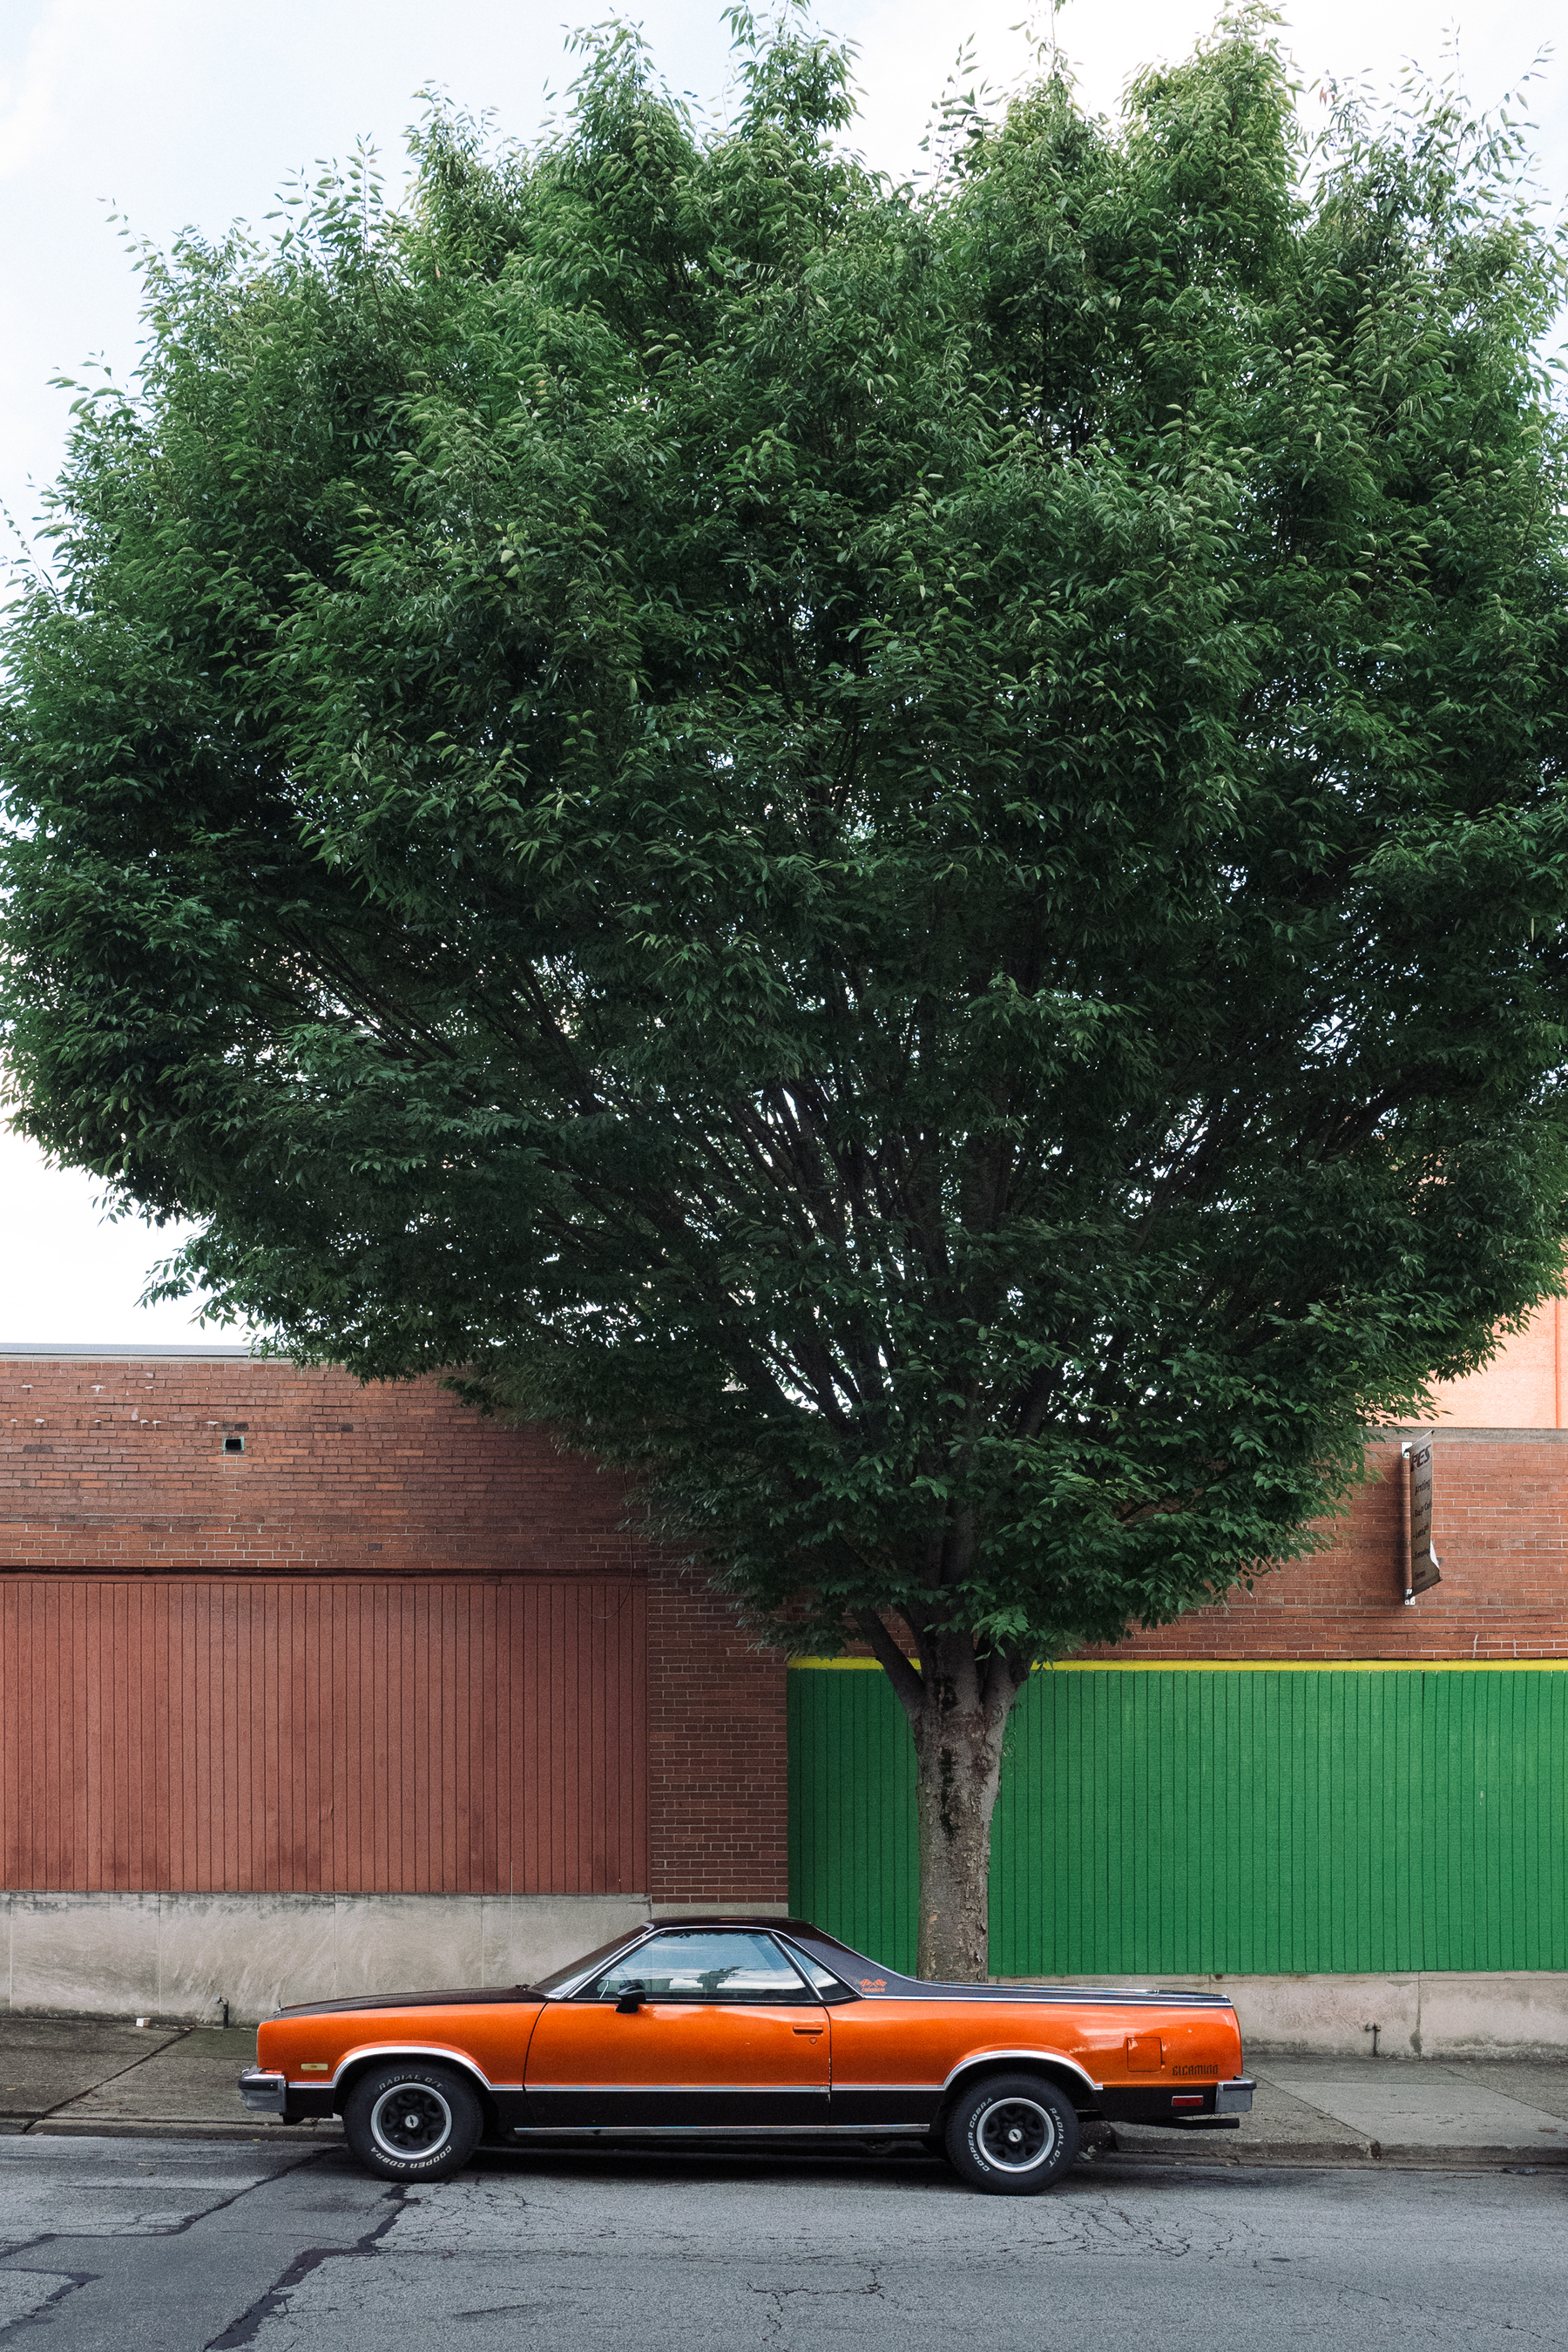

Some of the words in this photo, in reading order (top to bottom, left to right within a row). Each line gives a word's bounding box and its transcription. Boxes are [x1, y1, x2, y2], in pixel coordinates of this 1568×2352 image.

[378, 2074, 421, 2091] RADIAL
[969, 2097, 993, 2129] COBRA
[1049, 2107, 1065, 2147] RADIAL
[370, 2146, 406, 2168] COBRA
[409, 2145, 452, 2169] COOPER
[967, 2132, 990, 2172] COOPER
